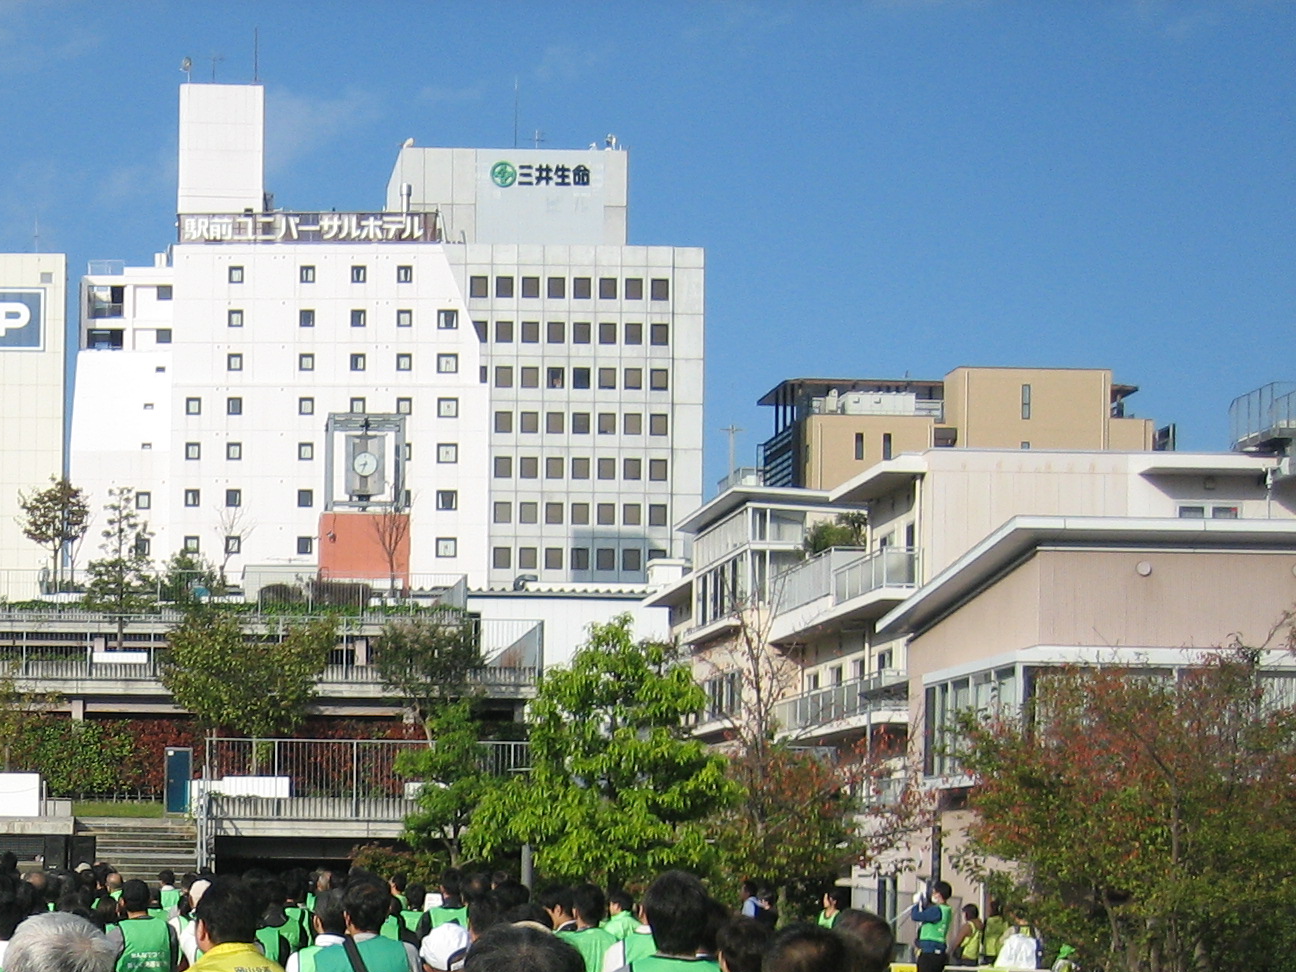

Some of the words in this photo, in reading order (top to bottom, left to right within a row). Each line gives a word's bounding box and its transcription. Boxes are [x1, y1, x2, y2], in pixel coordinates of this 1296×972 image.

[517, 164, 591, 186] 三井生命
[185, 216, 424, 240] 駅前ユニバーサルホテル
